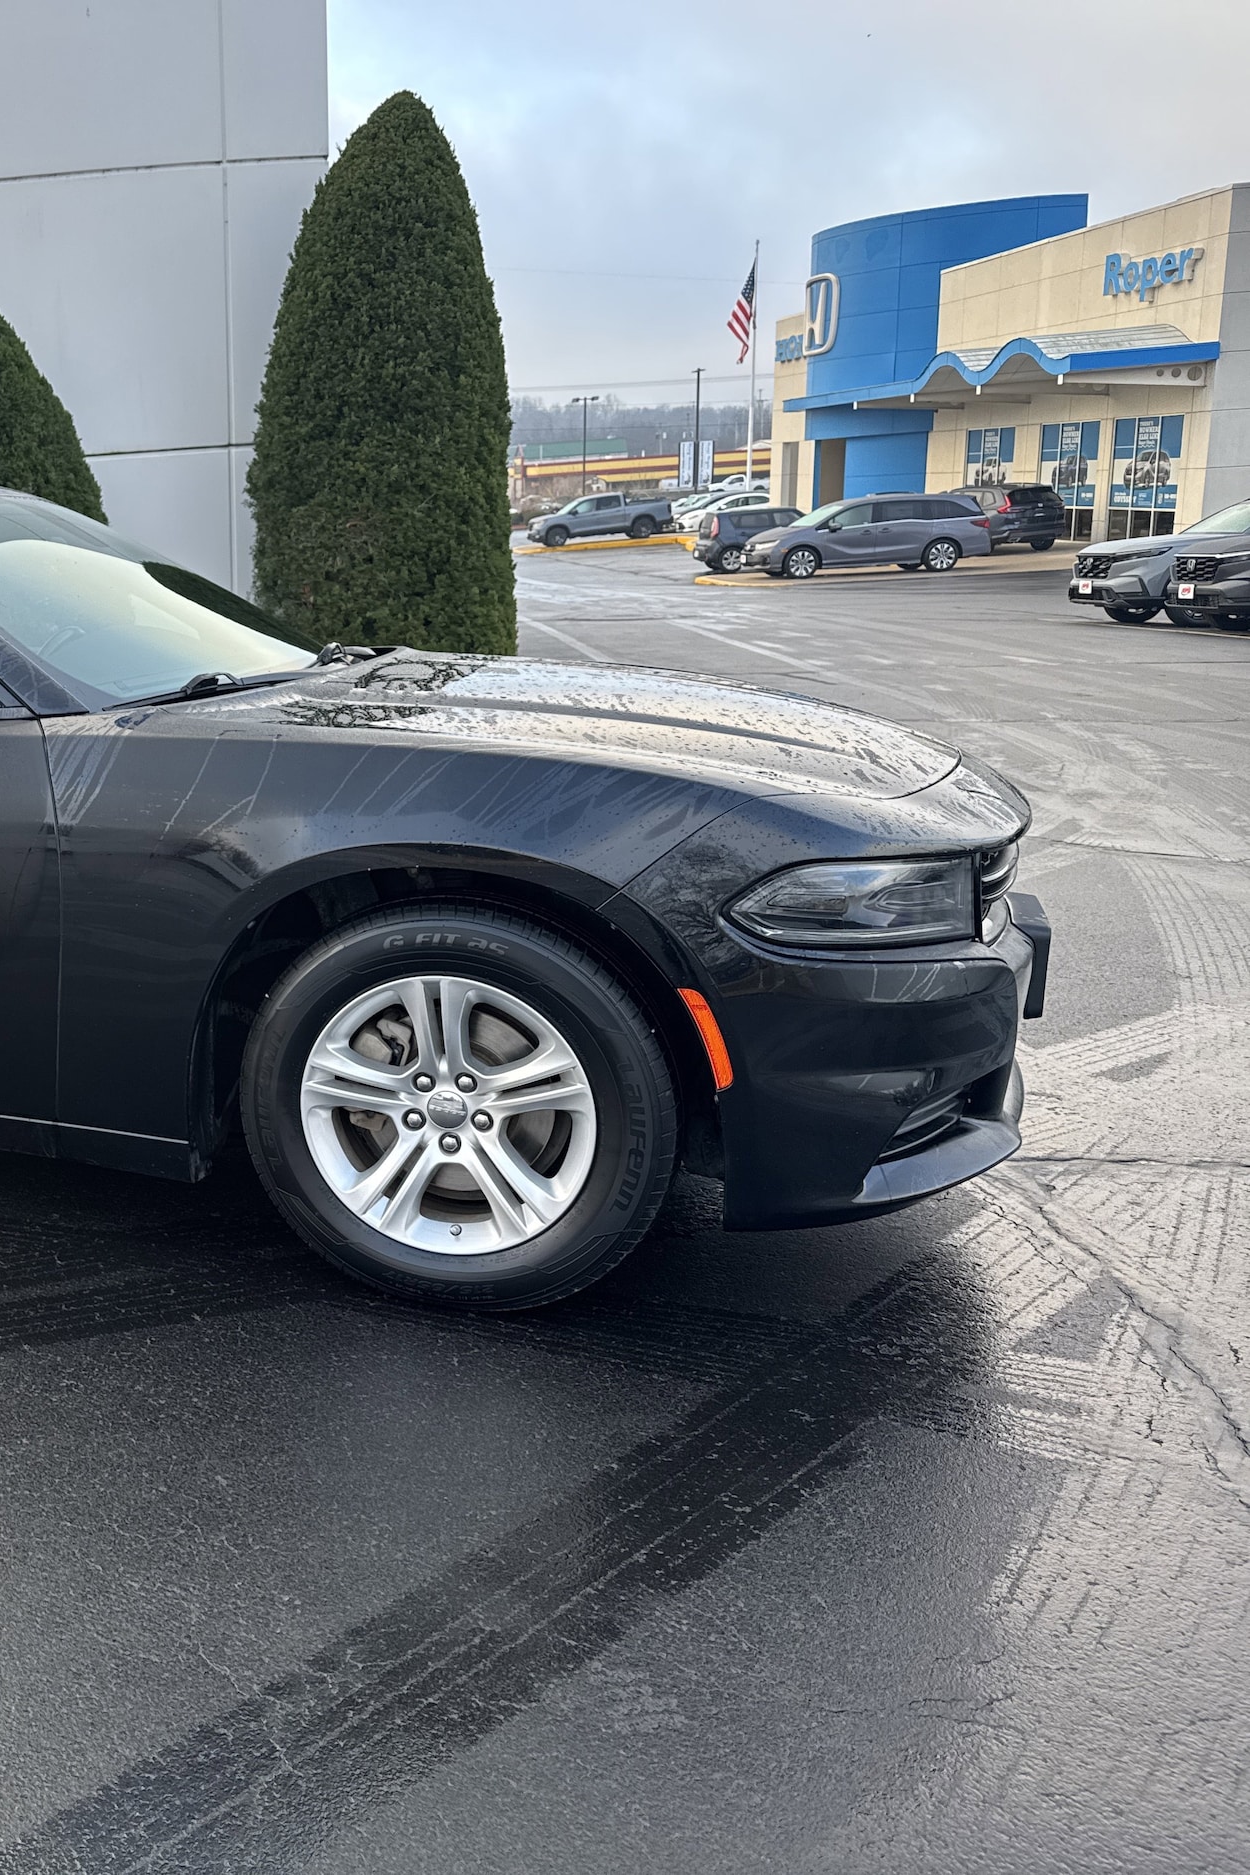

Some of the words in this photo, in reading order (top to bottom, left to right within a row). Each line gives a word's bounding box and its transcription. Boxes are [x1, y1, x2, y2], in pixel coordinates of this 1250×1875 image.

[1102, 247, 1196, 302] Roper
[383, 934, 404, 950] G
[415, 933, 461, 945] FIT
[609, 1056, 647, 1212] Laufenn
